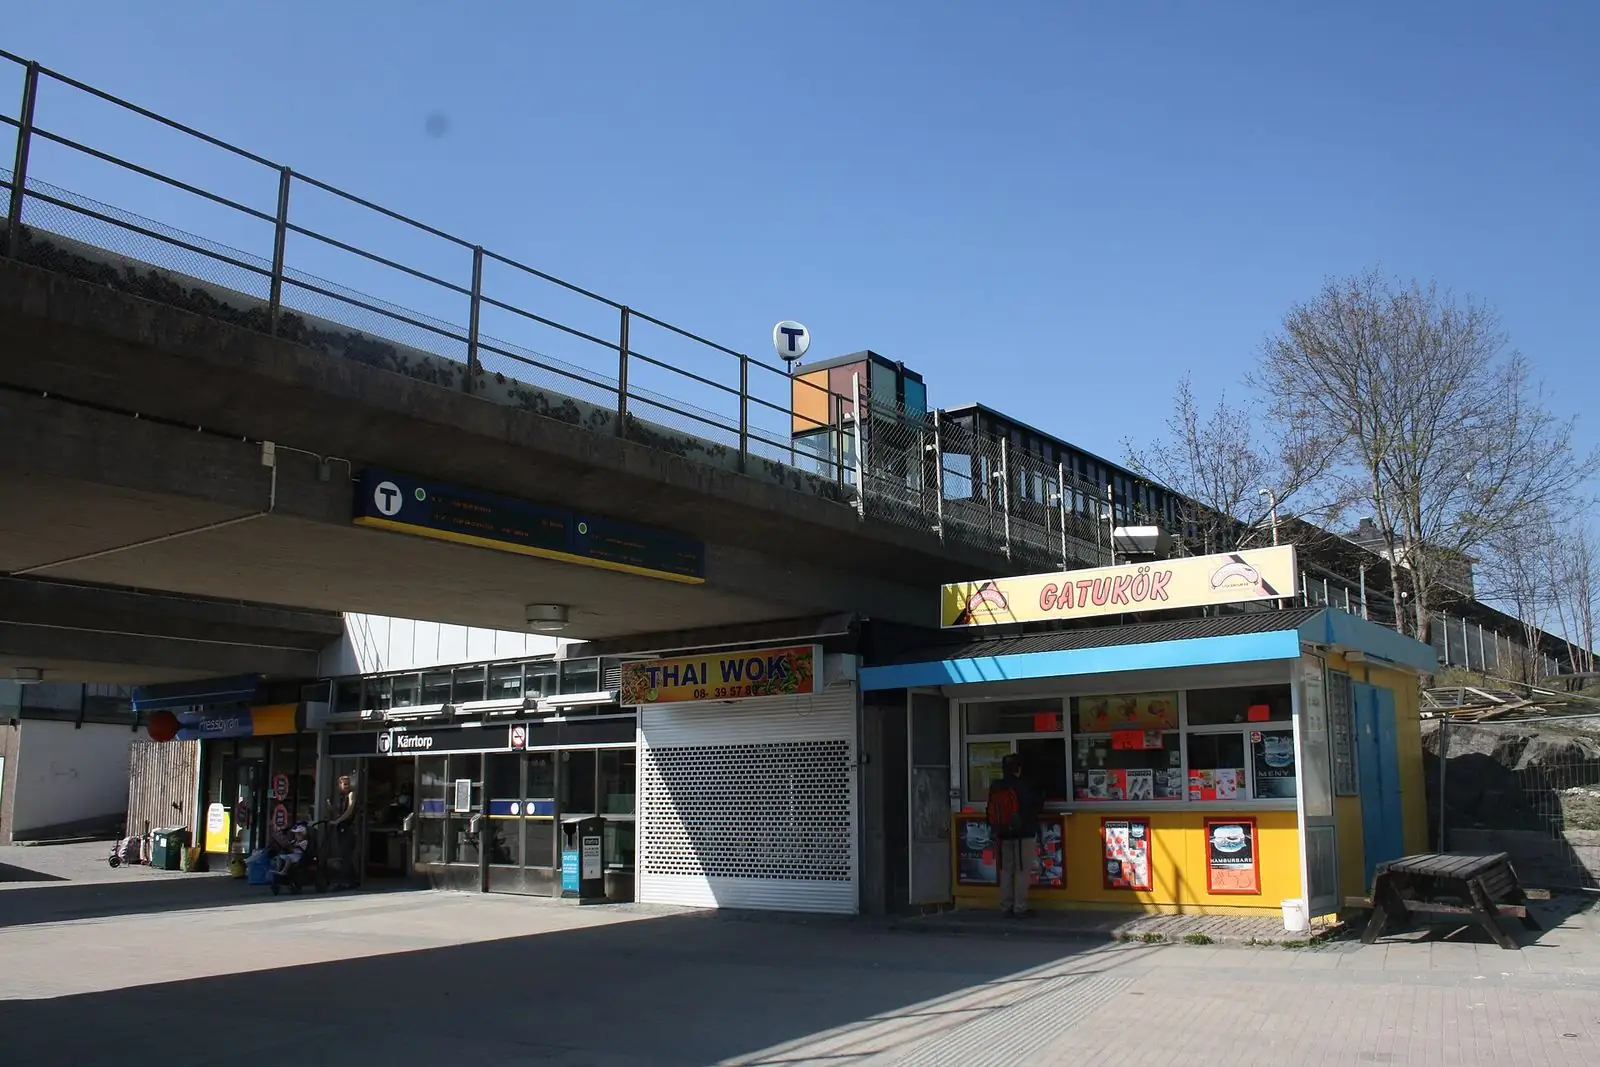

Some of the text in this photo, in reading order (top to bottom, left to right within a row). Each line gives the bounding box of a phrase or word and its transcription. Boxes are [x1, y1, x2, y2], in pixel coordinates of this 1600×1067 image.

[781, 327, 803, 352] T
[379, 487, 398, 512] T
[1039, 566, 1173, 611] GATUKÖK
[645, 655, 787, 688] THAI WOK
[714, 686, 727, 698] 39
[381, 737, 389, 750] T
[397, 734, 433, 749] Kärrtorp
